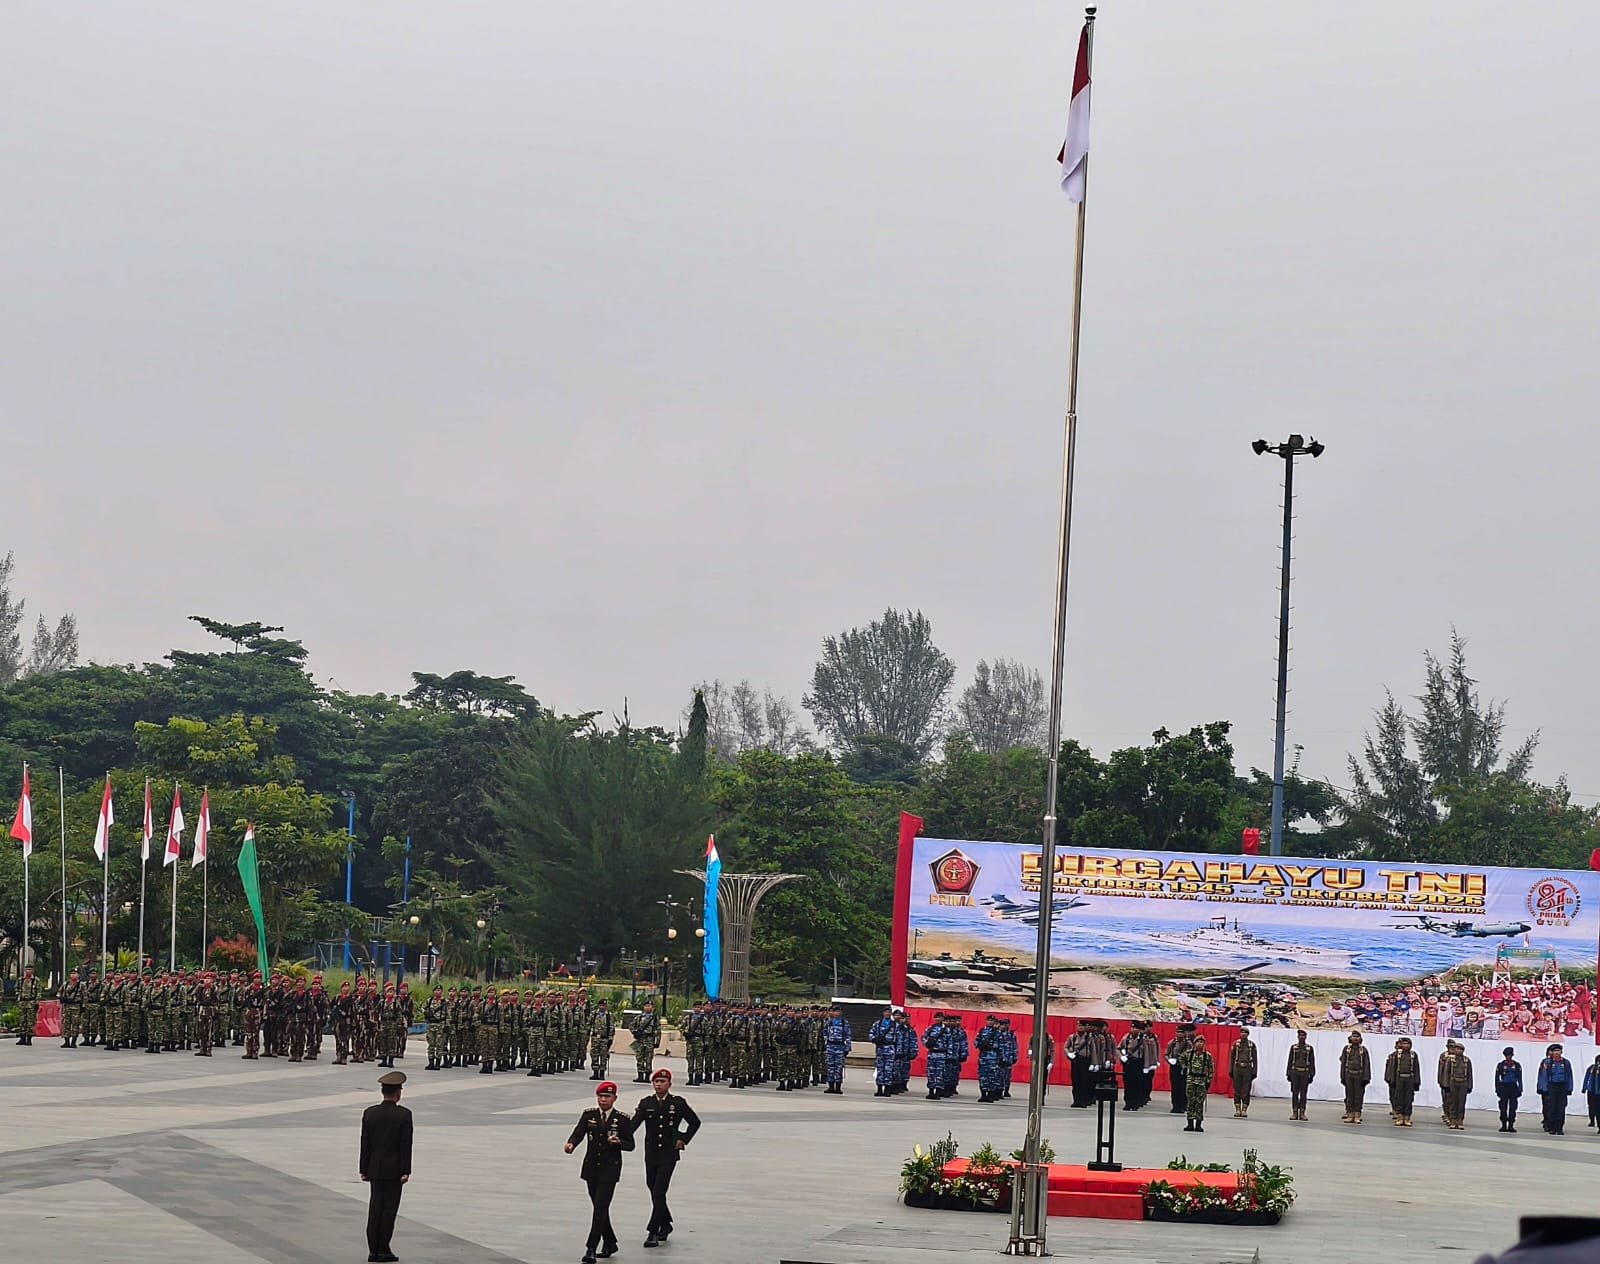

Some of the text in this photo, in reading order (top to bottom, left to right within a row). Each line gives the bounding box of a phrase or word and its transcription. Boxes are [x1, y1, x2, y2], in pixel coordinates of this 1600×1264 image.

[1021, 852, 1486, 896] DIRGAHAYU TNI
[929, 893, 977, 907] PRIMA
[1021, 873, 1041, 886] 5
[1053, 876, 1164, 892] OKTOBER
[1167, 881, 1235, 896] 1945
[1263, 885, 1285, 898] 5
[1291, 887, 1406, 904] OKTOBER
[1409, 893, 1485, 908] 2026
[1206, 895, 1277, 905] INDONESIA
[1392, 904, 1420, 912] DAN
[1423, 906, 1486, 916] MAKMUR
[1539, 911, 1567, 919] PRIMA
